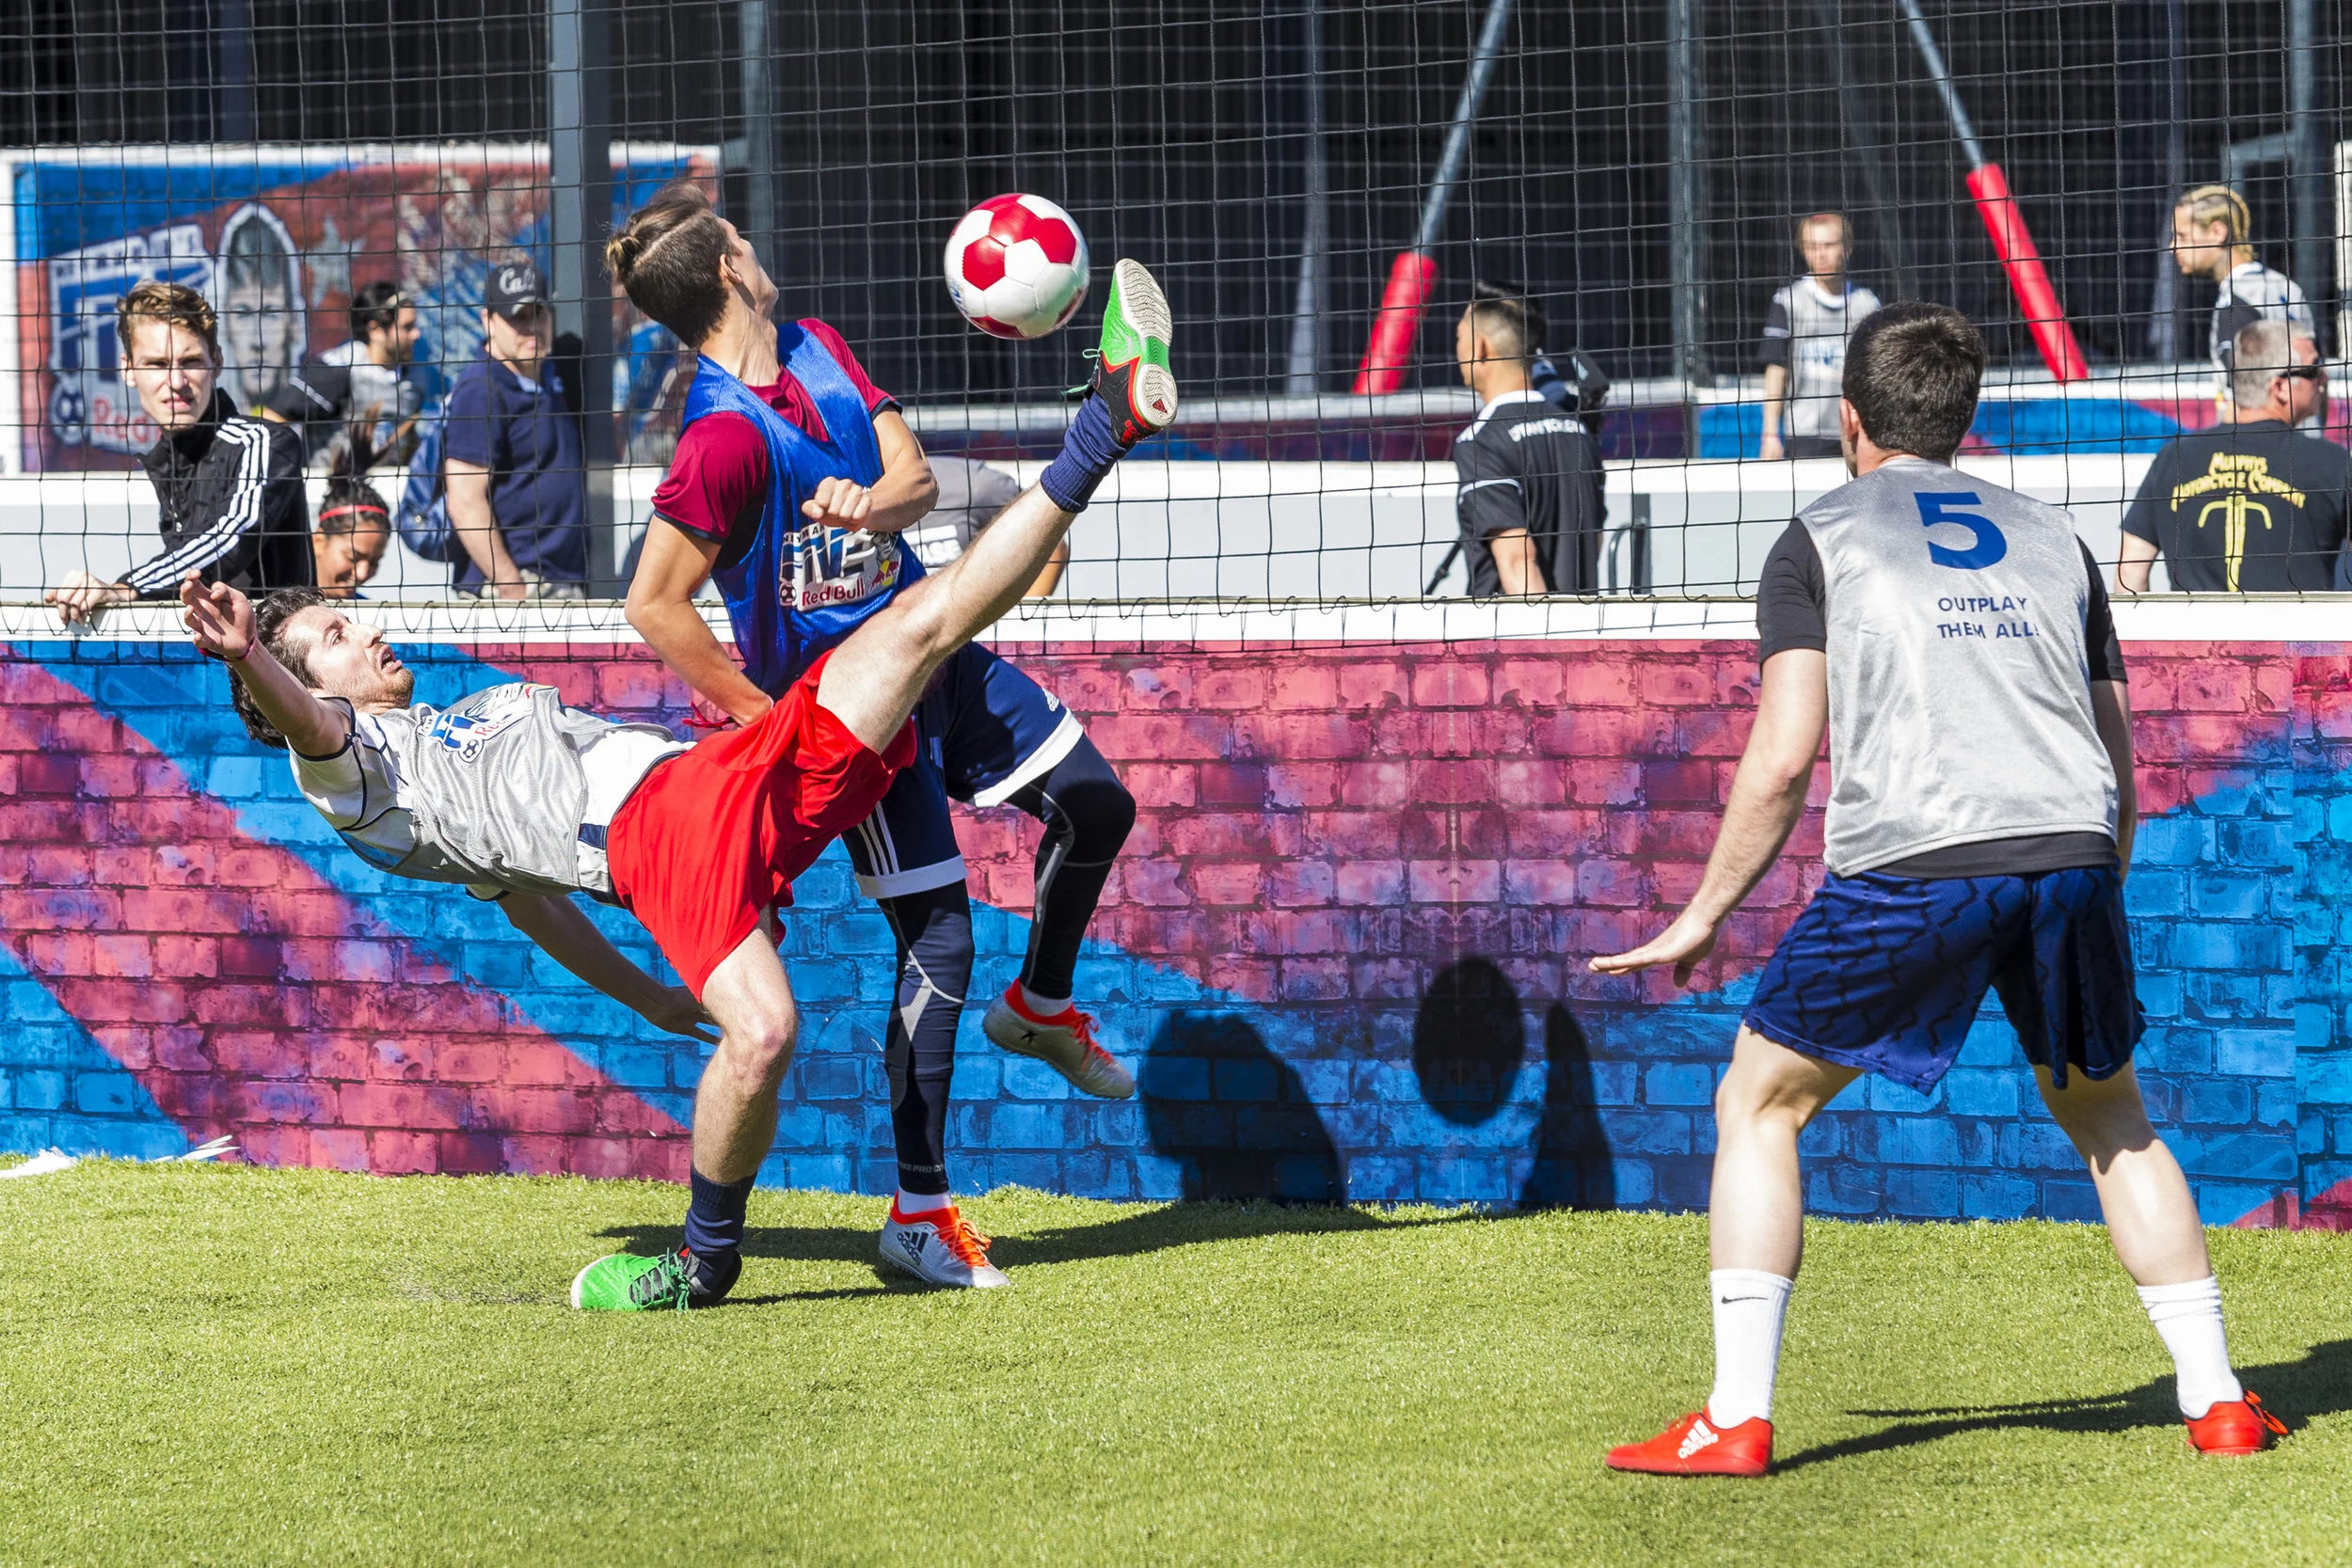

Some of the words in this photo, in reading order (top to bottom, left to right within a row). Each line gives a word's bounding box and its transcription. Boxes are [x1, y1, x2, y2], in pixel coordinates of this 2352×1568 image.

[1913, 491, 2008, 571] 5
[802, 585, 831, 607] Red
[834, 577, 865, 601] Bull
[1937, 595, 2027, 612] OUTPLAY
[1936, 622, 1987, 639] THEM
[1995, 621, 2040, 639] ALL!
[897, 1232, 922, 1266] adidas
